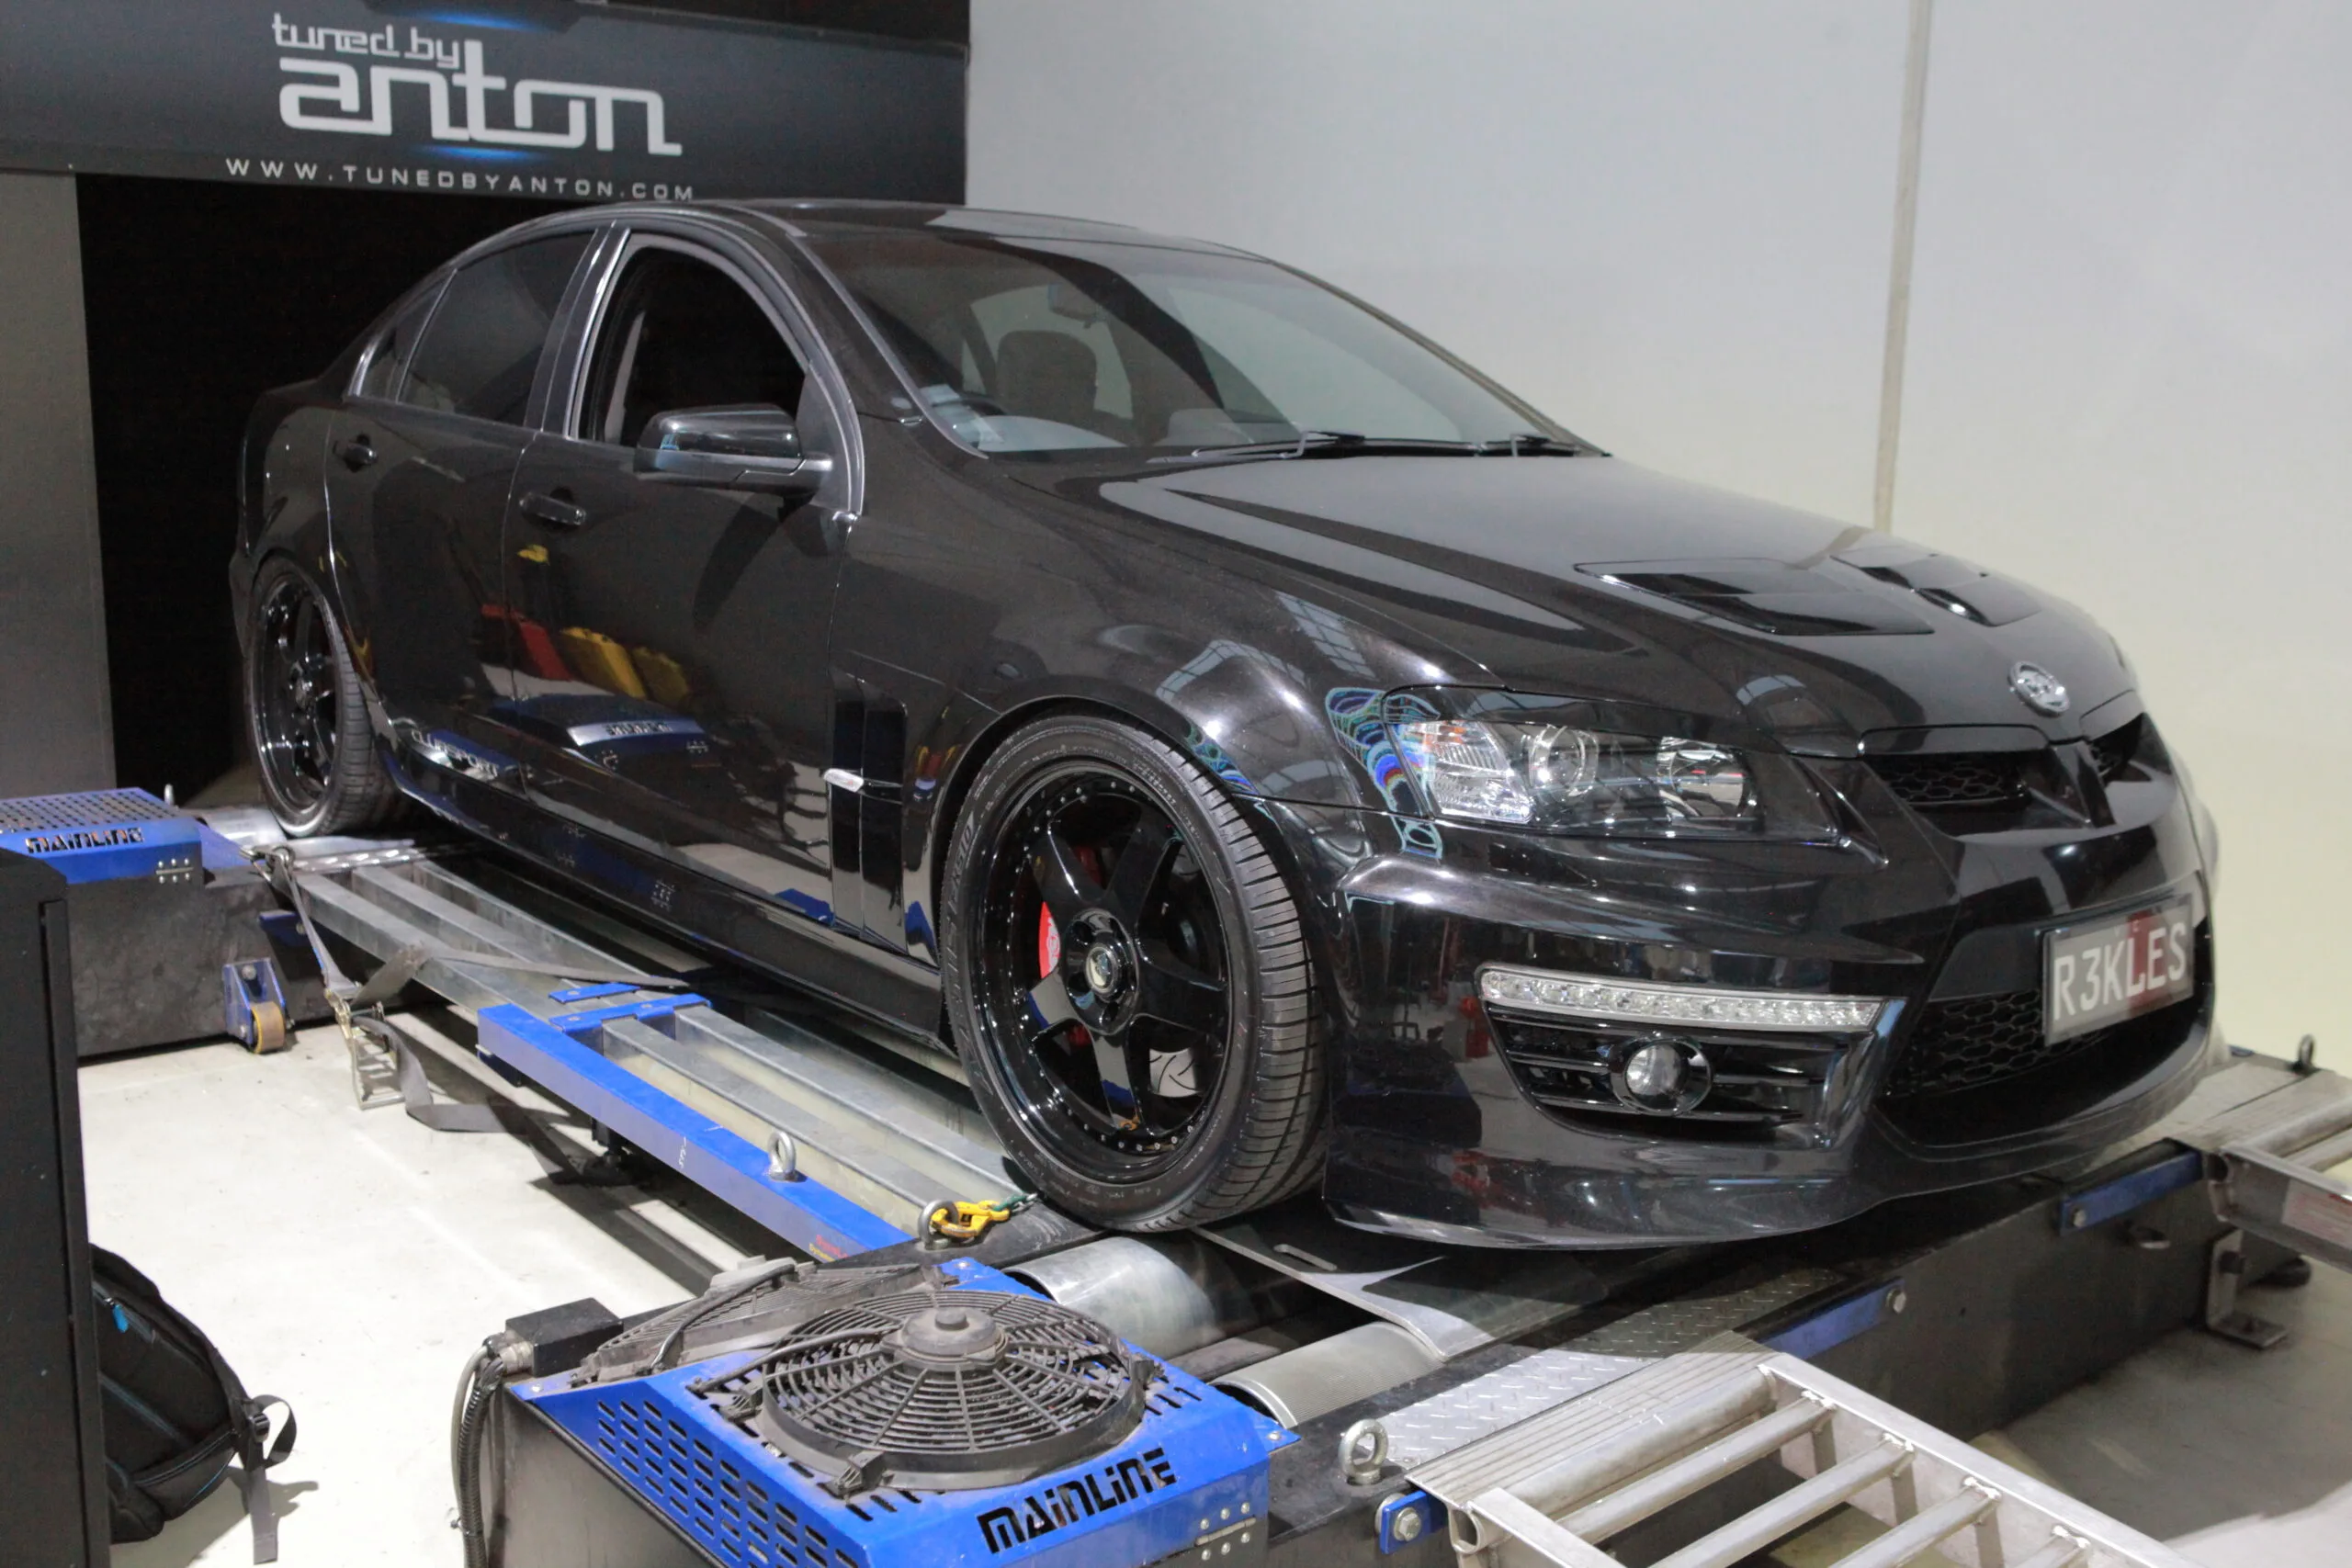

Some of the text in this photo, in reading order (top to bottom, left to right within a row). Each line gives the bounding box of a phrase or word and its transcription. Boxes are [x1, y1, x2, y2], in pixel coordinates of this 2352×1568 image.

[272, 13, 459, 69] tuned by
[278, 39, 683, 156] anton
[225, 158, 694, 201] WWW.TUNEDBYANTON.COM
[25, 828, 145, 853] MAINLINE
[2052, 922, 2187, 1021] R3KLES
[977, 1447, 1177, 1555] MAINLINE
